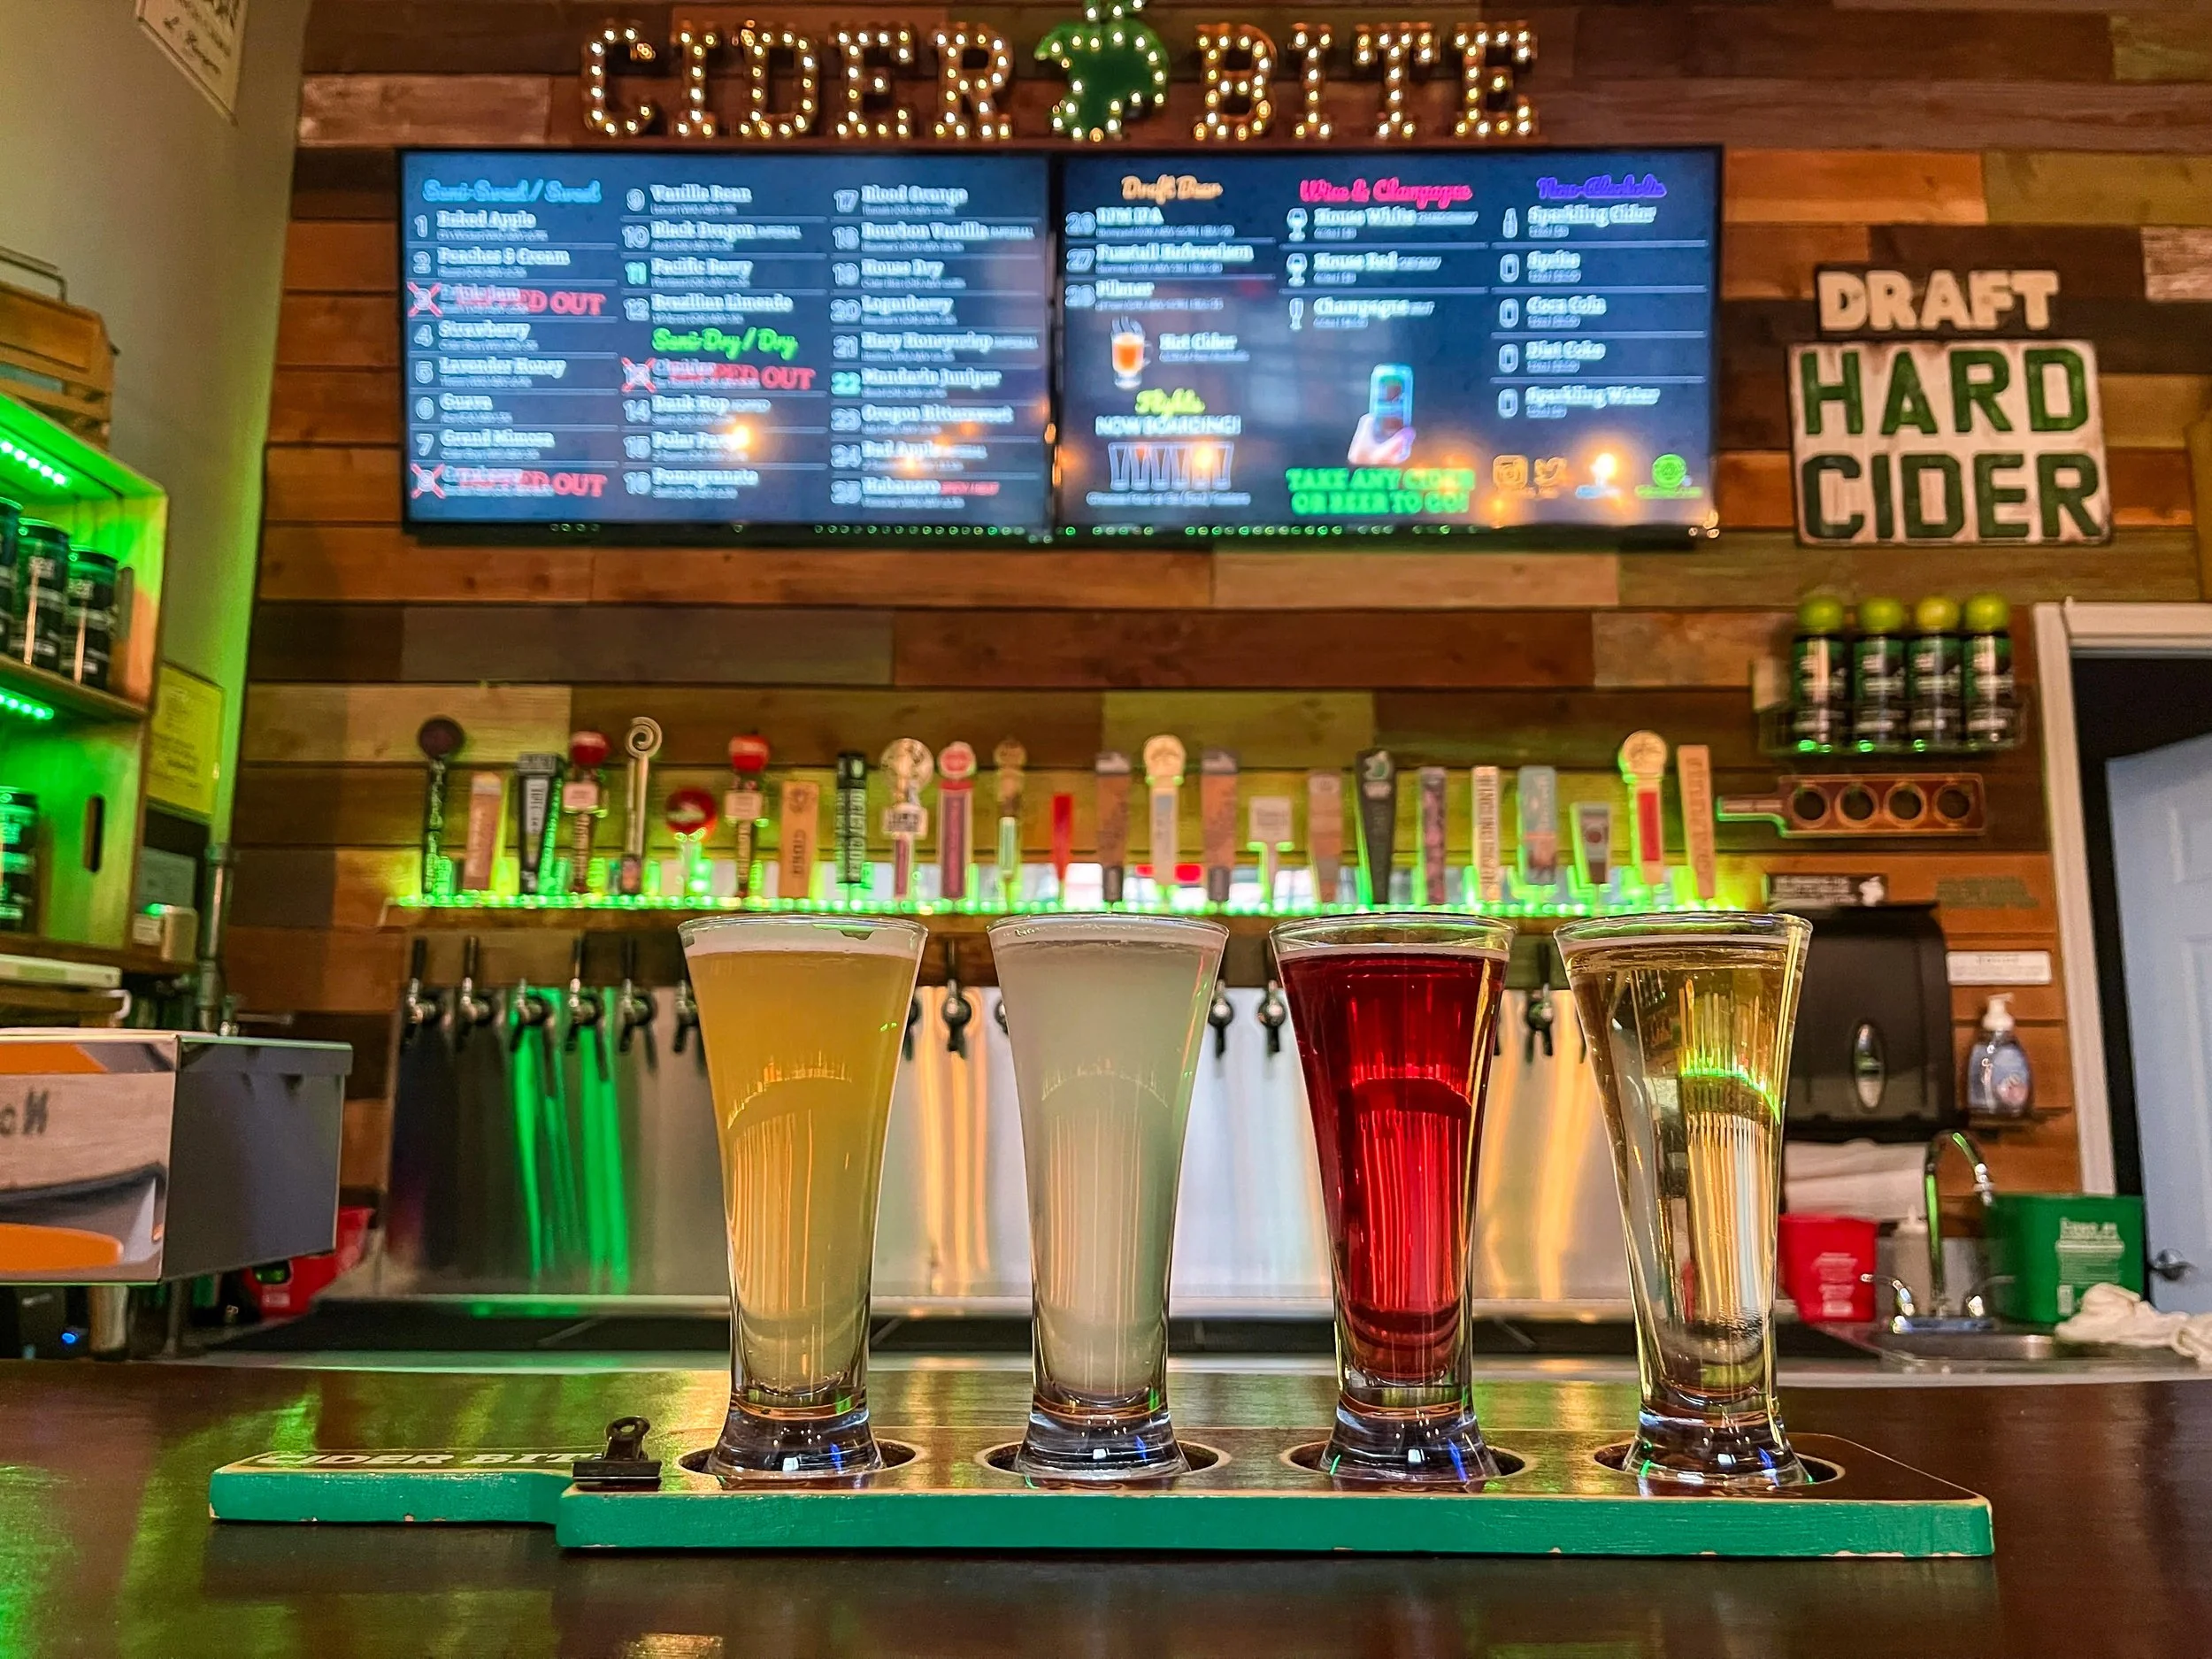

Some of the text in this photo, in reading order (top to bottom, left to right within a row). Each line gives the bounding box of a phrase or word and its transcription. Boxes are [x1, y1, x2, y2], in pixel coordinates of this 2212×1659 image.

[580, 19, 1538, 140] CIDER BITE
[650, 183, 709, 203] Vanilla
[709, 184, 752, 203] Bean
[861, 184, 907, 204] Blood
[908, 185, 968, 206] Orange
[1121, 174, 1177, 204] Draft
[1300, 179, 1350, 203] Wine
[1373, 177, 1473, 210] Champagne
[413, 214, 428, 237] 1
[488, 211, 536, 231] Apple
[1527, 204, 1656, 228] Sparkling Cider
[622, 225, 649, 249] 10
[696, 221, 757, 242] Dragon
[930, 221, 989, 240] Vanilla
[413, 251, 431, 273] 2
[516, 247, 571, 265] Cream
[1066, 248, 1095, 273] 27
[625, 261, 647, 285] 11
[549, 292, 606, 316] OUT
[623, 297, 649, 321] 12
[831, 299, 861, 323] 20
[1313, 297, 1409, 319] Champagne
[1526, 295, 1607, 315] Coca Cola
[1816, 269, 2059, 331] DRAFT
[413, 325, 434, 347] 4
[439, 320, 531, 342] Strawberry
[757, 328, 799, 360] Dry
[1191, 332, 1238, 350] Cider
[415, 360, 434, 385] 5
[513, 357, 567, 379] Honey
[761, 366, 816, 390] OUT
[831, 372, 861, 395] 22
[1800, 348, 2089, 435] HARD
[1525, 385, 1660, 409] Sparkling Water
[623, 399, 650, 422] 14
[1095, 416, 1141, 435] NOW
[416, 433, 434, 457] 7
[492, 429, 556, 449] Mimosa
[552, 472, 608, 497] OUT
[1286, 468, 1475, 492] TAKE ANY CIDER
[1291, 490, 1328, 515] OR
[1329, 491, 1390, 514] BEER
[1390, 490, 1423, 514] TO
[1801, 451, 2102, 538] CIDER
[258, 1453, 603, 1465] CIDER BIT
